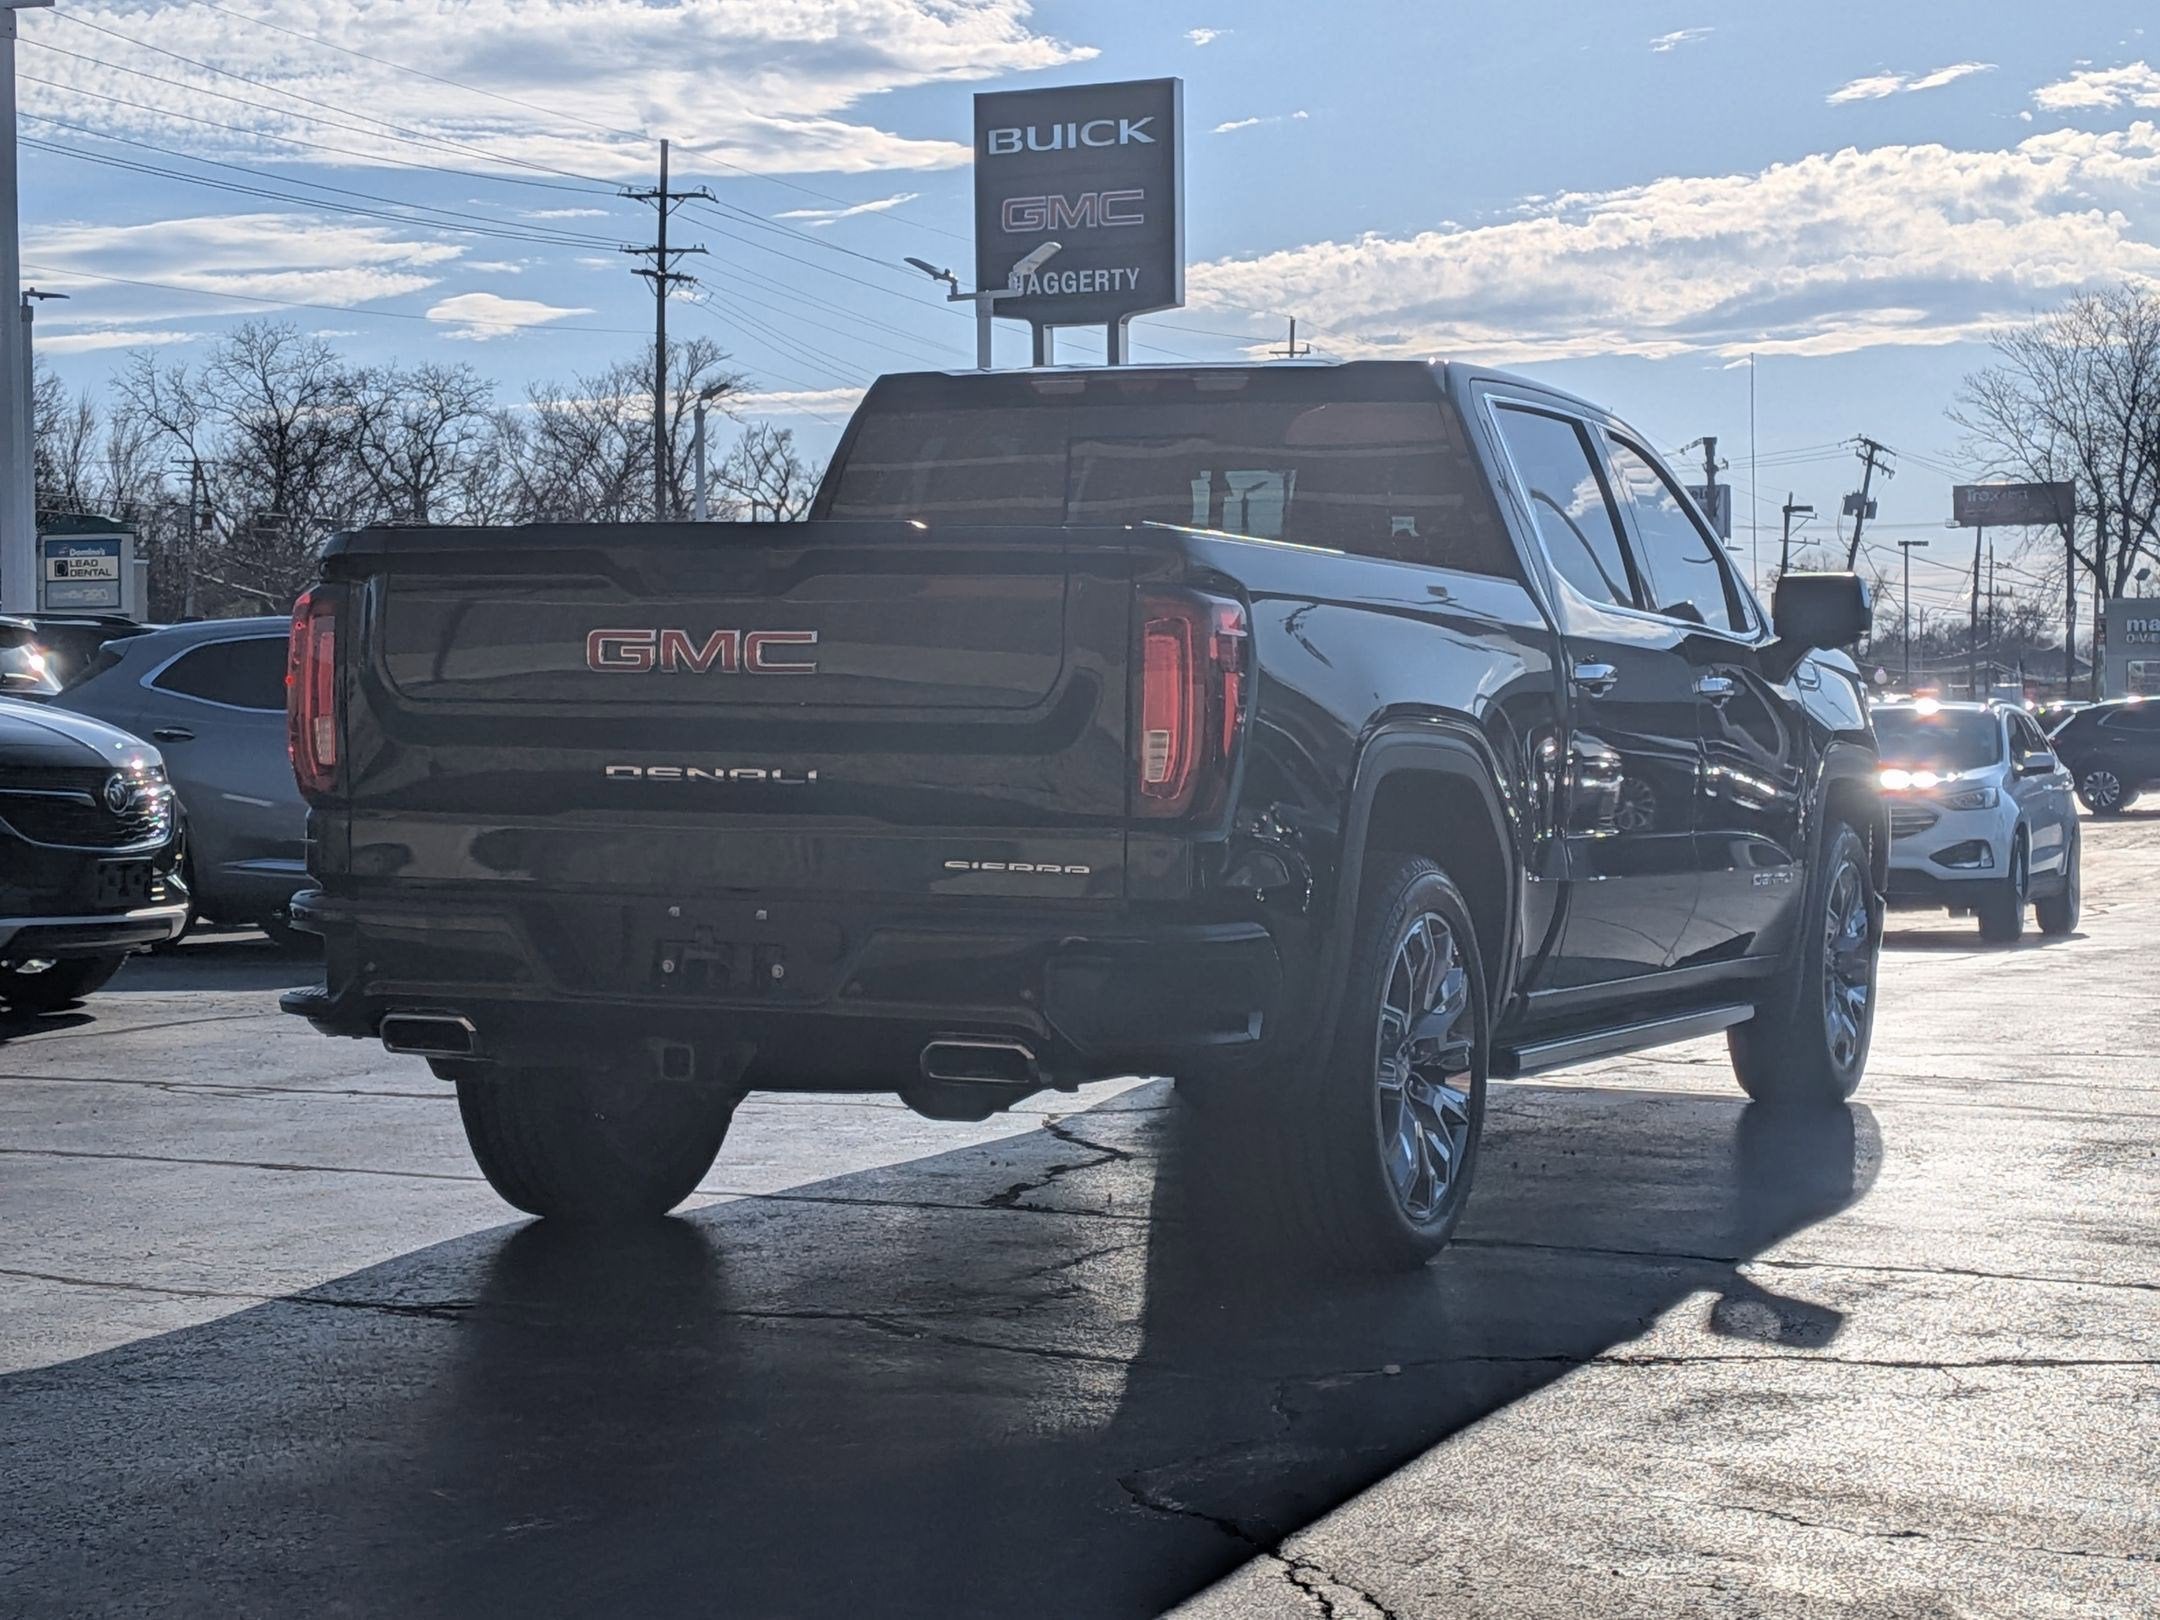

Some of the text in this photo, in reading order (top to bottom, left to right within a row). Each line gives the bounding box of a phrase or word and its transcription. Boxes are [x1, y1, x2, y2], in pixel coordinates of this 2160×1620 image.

[988, 116, 1156, 155] BUICK
[1002, 189, 1144, 233] GMC
[69, 559, 98, 567] LEAD
[70, 568, 112, 577] DENTAL
[586, 629, 818, 675] GMC
[605, 765, 818, 784] DENALI
[944, 860, 1091, 875] SIERRA
